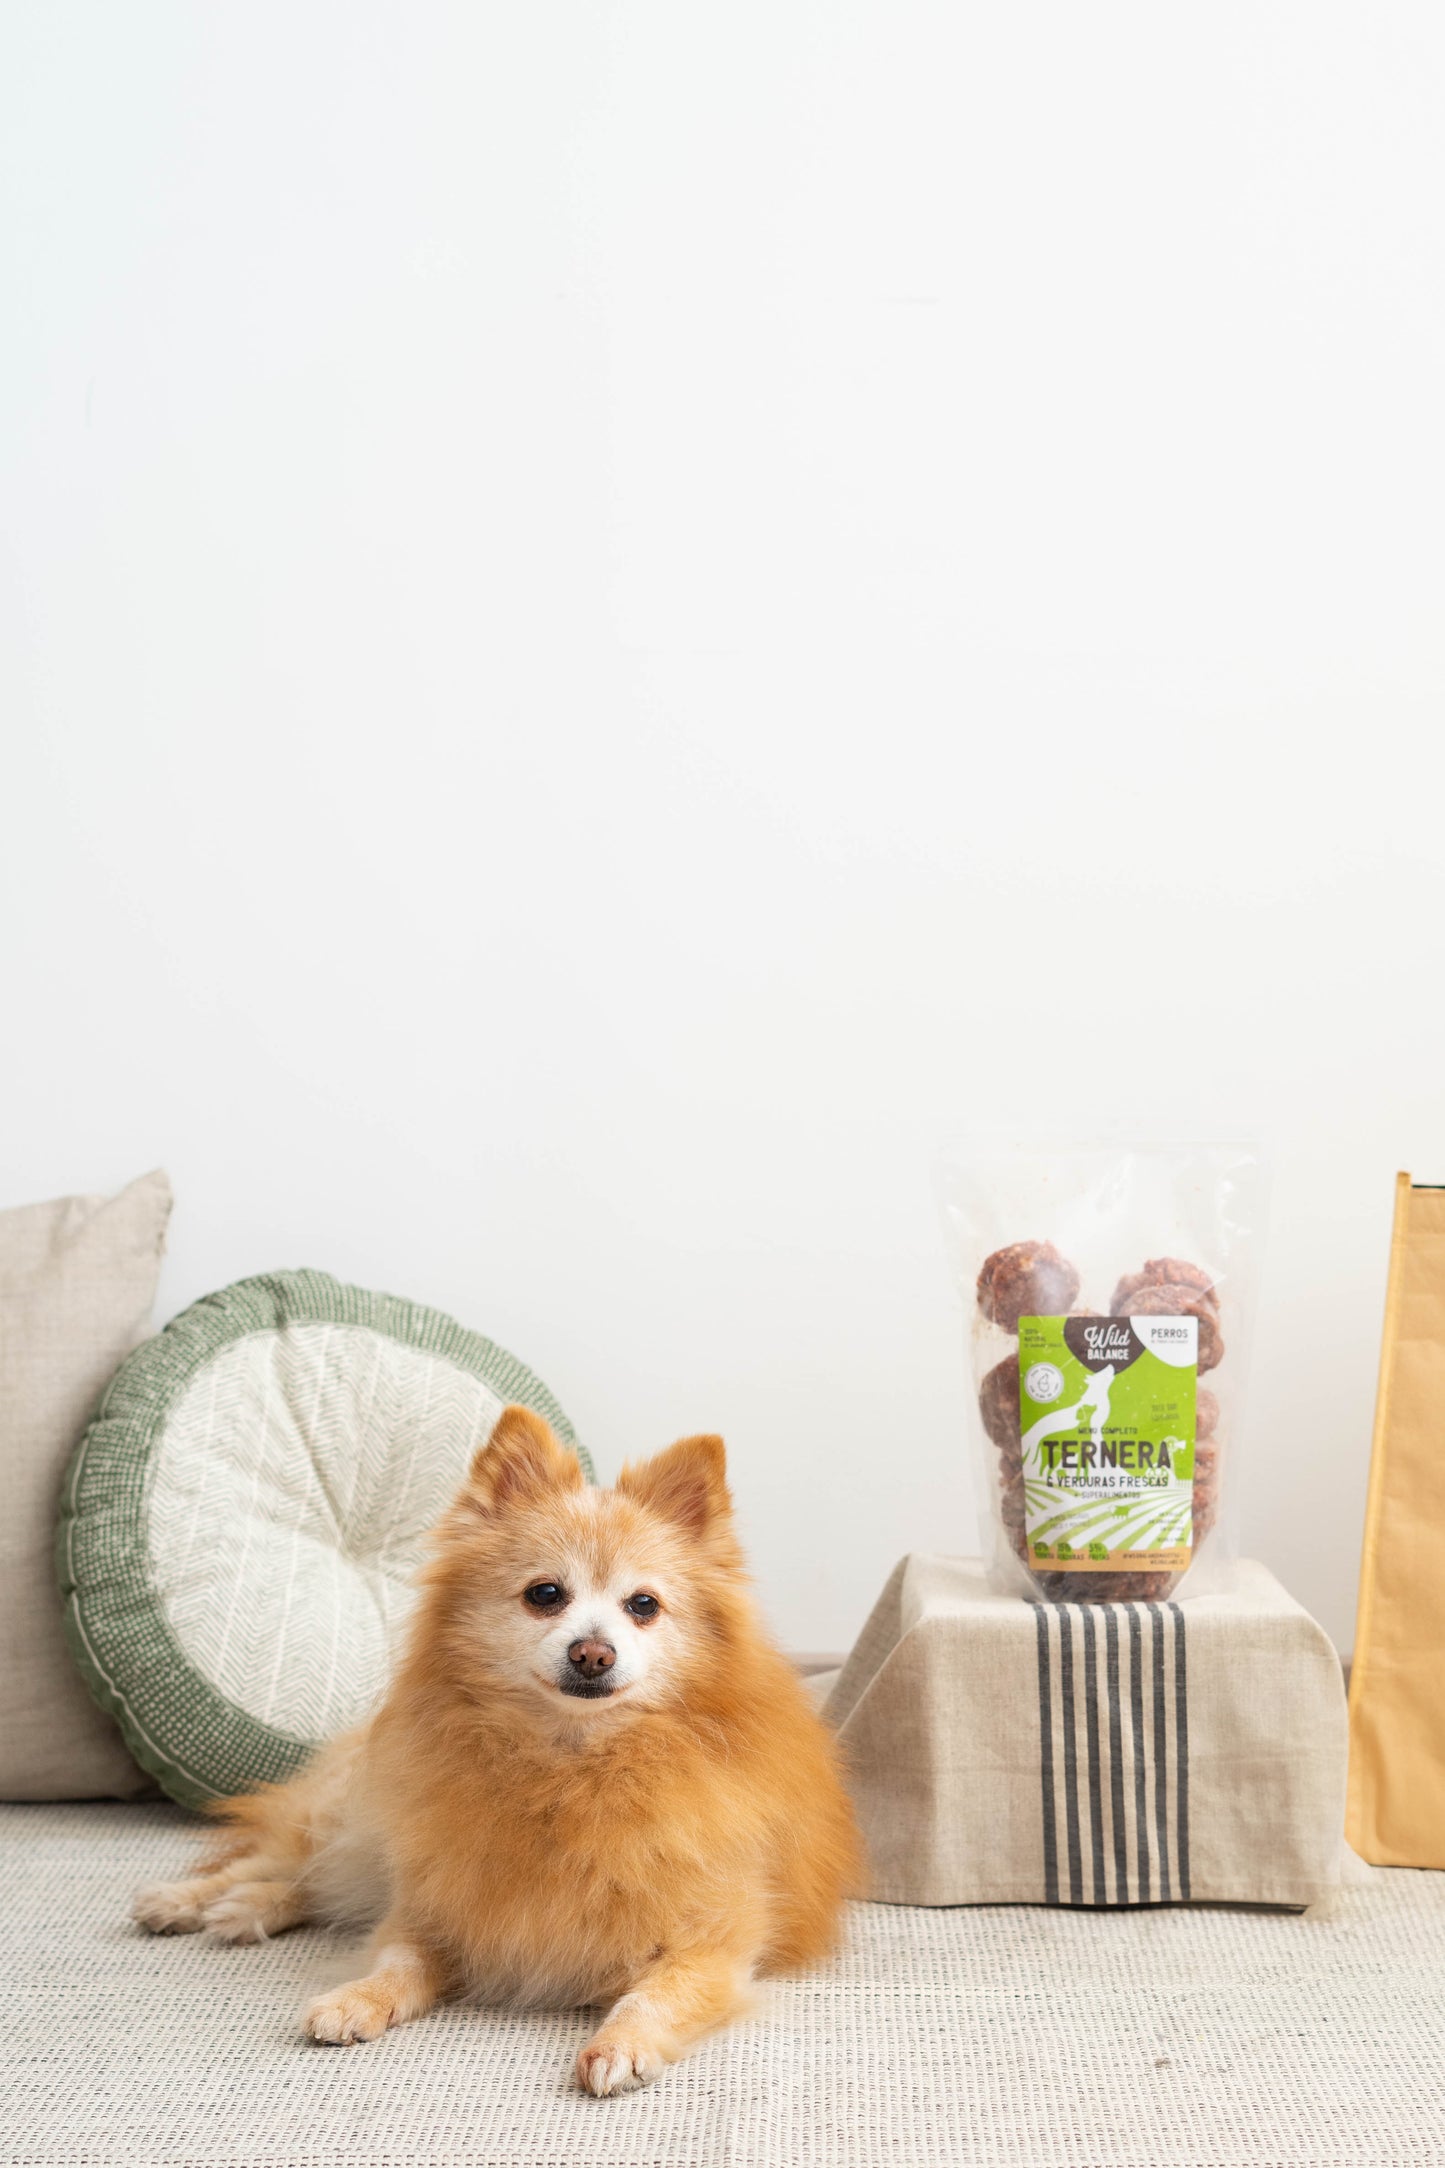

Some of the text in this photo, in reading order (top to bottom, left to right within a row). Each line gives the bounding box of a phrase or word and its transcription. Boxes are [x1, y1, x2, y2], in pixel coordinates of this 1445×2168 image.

[1084, 1324, 1130, 1348] Wild
[1151, 1328, 1189, 1338] PERROS
[1087, 1349, 1129, 1360] BALANCE
[1043, 1441, 1171, 1469] TERNERA
[1057, 1476, 1115, 1487] VERDURAS
[1119, 1476, 1168, 1487] FRESCAS
[1081, 1491, 1140, 1499] SUPERALIMENTOS
